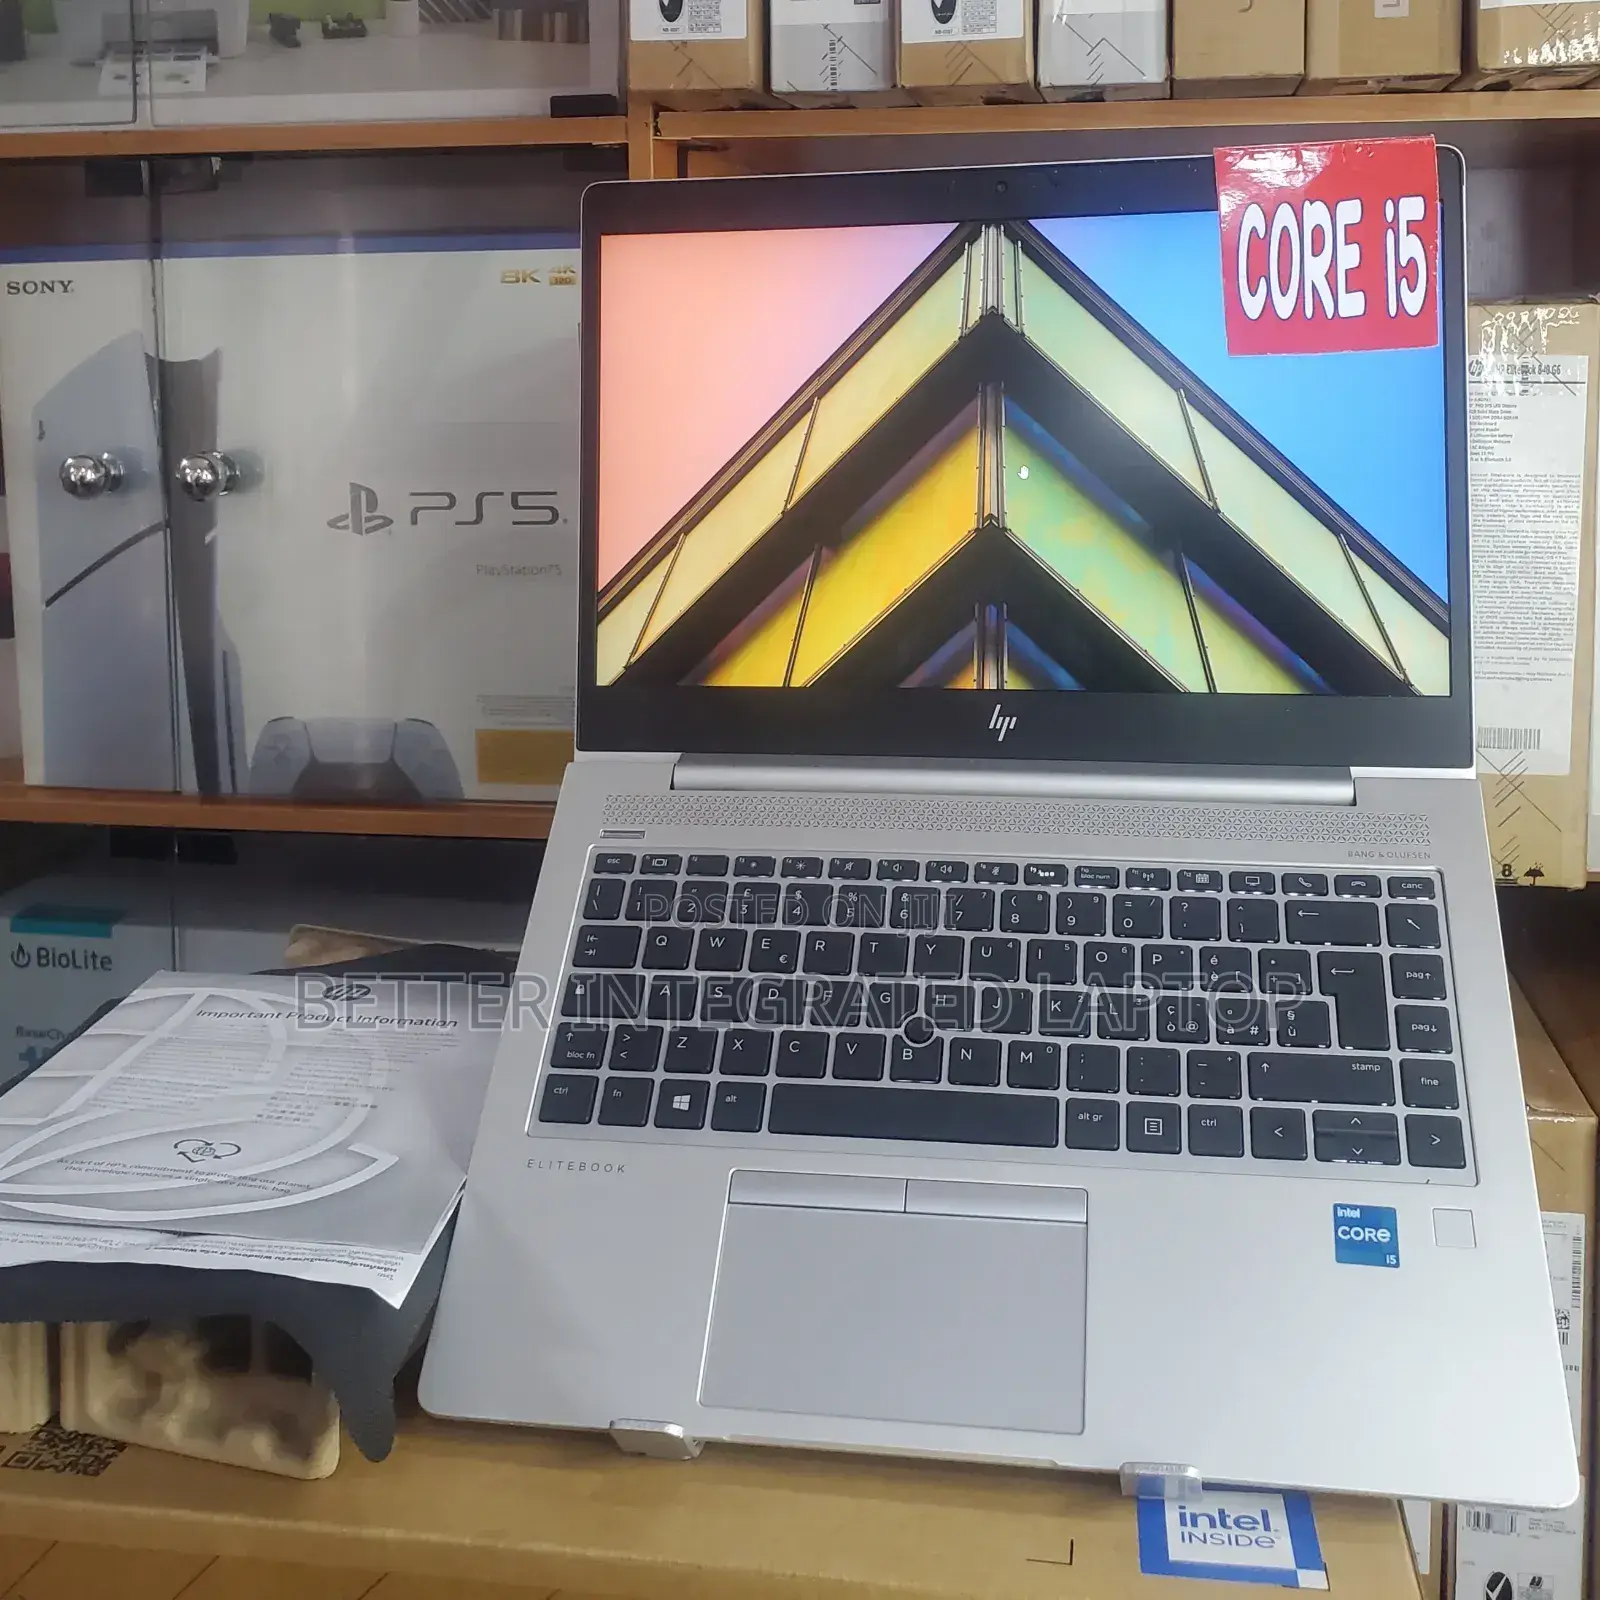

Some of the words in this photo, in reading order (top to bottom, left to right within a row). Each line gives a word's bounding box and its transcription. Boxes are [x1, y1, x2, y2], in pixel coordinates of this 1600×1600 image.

[1237, 198, 1367, 321] CORE
[1384, 195, 1429, 319] i5
[7, 280, 74, 295] SONY
[409, 491, 560, 526] PS5
[988, 704, 1017, 742] hp
[1387, 851, 1431, 859] OLUFSEN
[607, 857, 621, 865] esc
[848, 892, 858, 902] %
[687, 903, 696, 913] 2
[740, 905, 748, 914] 3
[792, 906, 801, 916] 4
[846, 908, 855, 917] 5
[900, 909, 909, 919] 6
[956, 911, 964, 921] 7
[1010, 913, 1020, 924] 8
[1067, 915, 1076, 926] 9
[655, 935, 668, 946] Q
[709, 936, 726, 948] W
[761, 938, 771, 949] E
[815, 940, 826, 951] R
[1007, 941, 1013, 949] 4
[870, 942, 879, 953] T
[926, 943, 936, 955] Y
[981, 946, 991, 958] U
[1064, 943, 1070, 951] 5
[1122, 946, 1127, 954] 6
[37, 946, 113, 972] BioLite
[779, 954, 788, 963] €
[1095, 951, 1108, 963] O
[1152, 953, 1163, 965] P
[1406, 971, 1424, 980] pag
[659, 985, 671, 996] A
[714, 986, 723, 998] S
[768, 988, 779, 1000] D
[880, 992, 891, 1003] G
[935, 994, 947, 1006] H
[992, 996, 1000, 1008] J
[1051, 1000, 1062, 1012] K
[196, 1009, 282, 1020] Important
[285, 1010, 354, 1023] Product
[356, 1014, 458, 1028] Information
[1185, 1021, 1199, 1033] @
[1411, 1023, 1430, 1032] pag
[677, 1037, 688, 1048] Z
[732, 1038, 744, 1050] X
[789, 1040, 800, 1053] C
[846, 1042, 858, 1055] V
[903, 1048, 913, 1060] B
[960, 1048, 972, 1060] N
[566, 1050, 585, 1059] bloc
[586, 1051, 595, 1059] fn
[1020, 1051, 1033, 1064] M
[1351, 1062, 1381, 1072] stamp
[1420, 1077, 1439, 1086] fine
[553, 1086, 569, 1095] ctrl
[612, 1089, 622, 1097] fn
[725, 1094, 737, 1103] alt
[1078, 1112, 1090, 1121] alt
[1092, 1114, 1103, 1123] gr
[1201, 1118, 1217, 1127] ctrl
[527, 1158, 627, 1174] ELITEBOOK
[1337, 1206, 1360, 1218] intel
